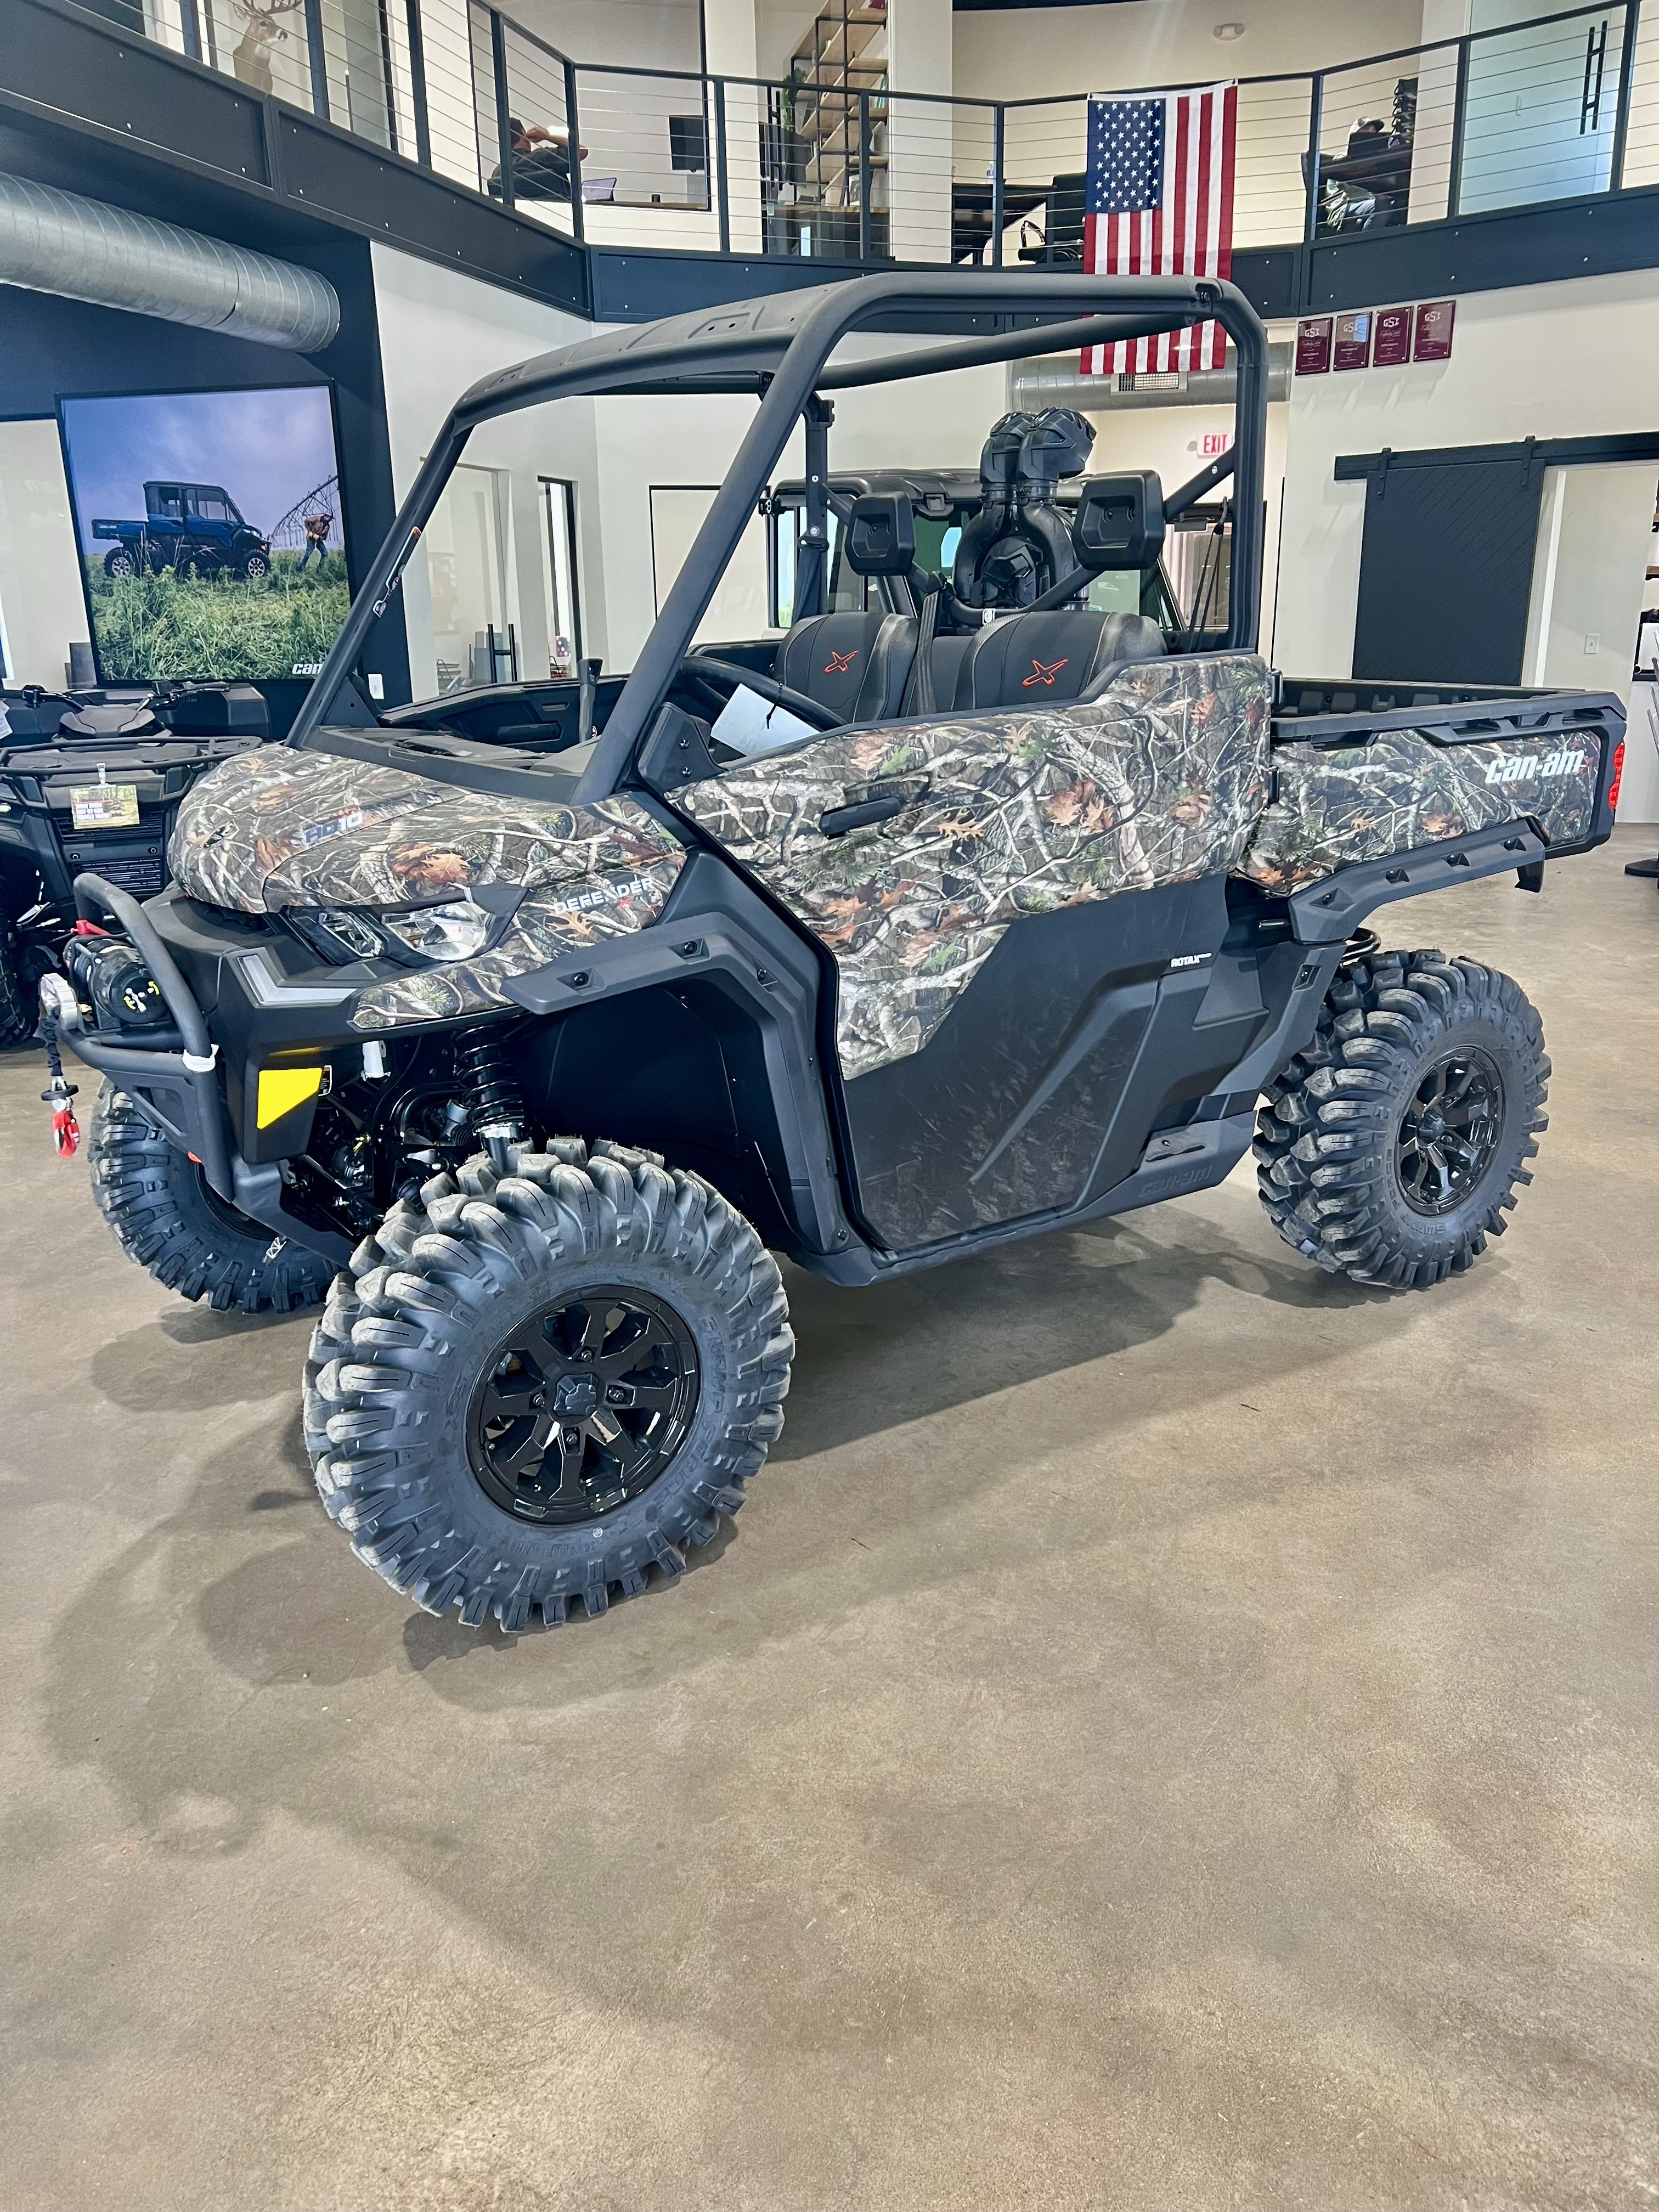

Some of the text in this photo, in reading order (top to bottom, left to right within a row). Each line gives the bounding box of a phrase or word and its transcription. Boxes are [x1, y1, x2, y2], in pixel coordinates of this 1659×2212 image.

[1383, 317, 1400, 328] GSI
[1424, 311, 1441, 322] GSI
[1305, 328, 1320, 337] GSI
[1343, 322, 1357, 332] GS
[1204, 434, 1228, 453] EXIT
[1485, 749, 1585, 784] can-am
[305, 811, 363, 844] HD10
[552, 877, 654, 915] DEFENDER
[1171, 955, 1200, 968] ROTAX
